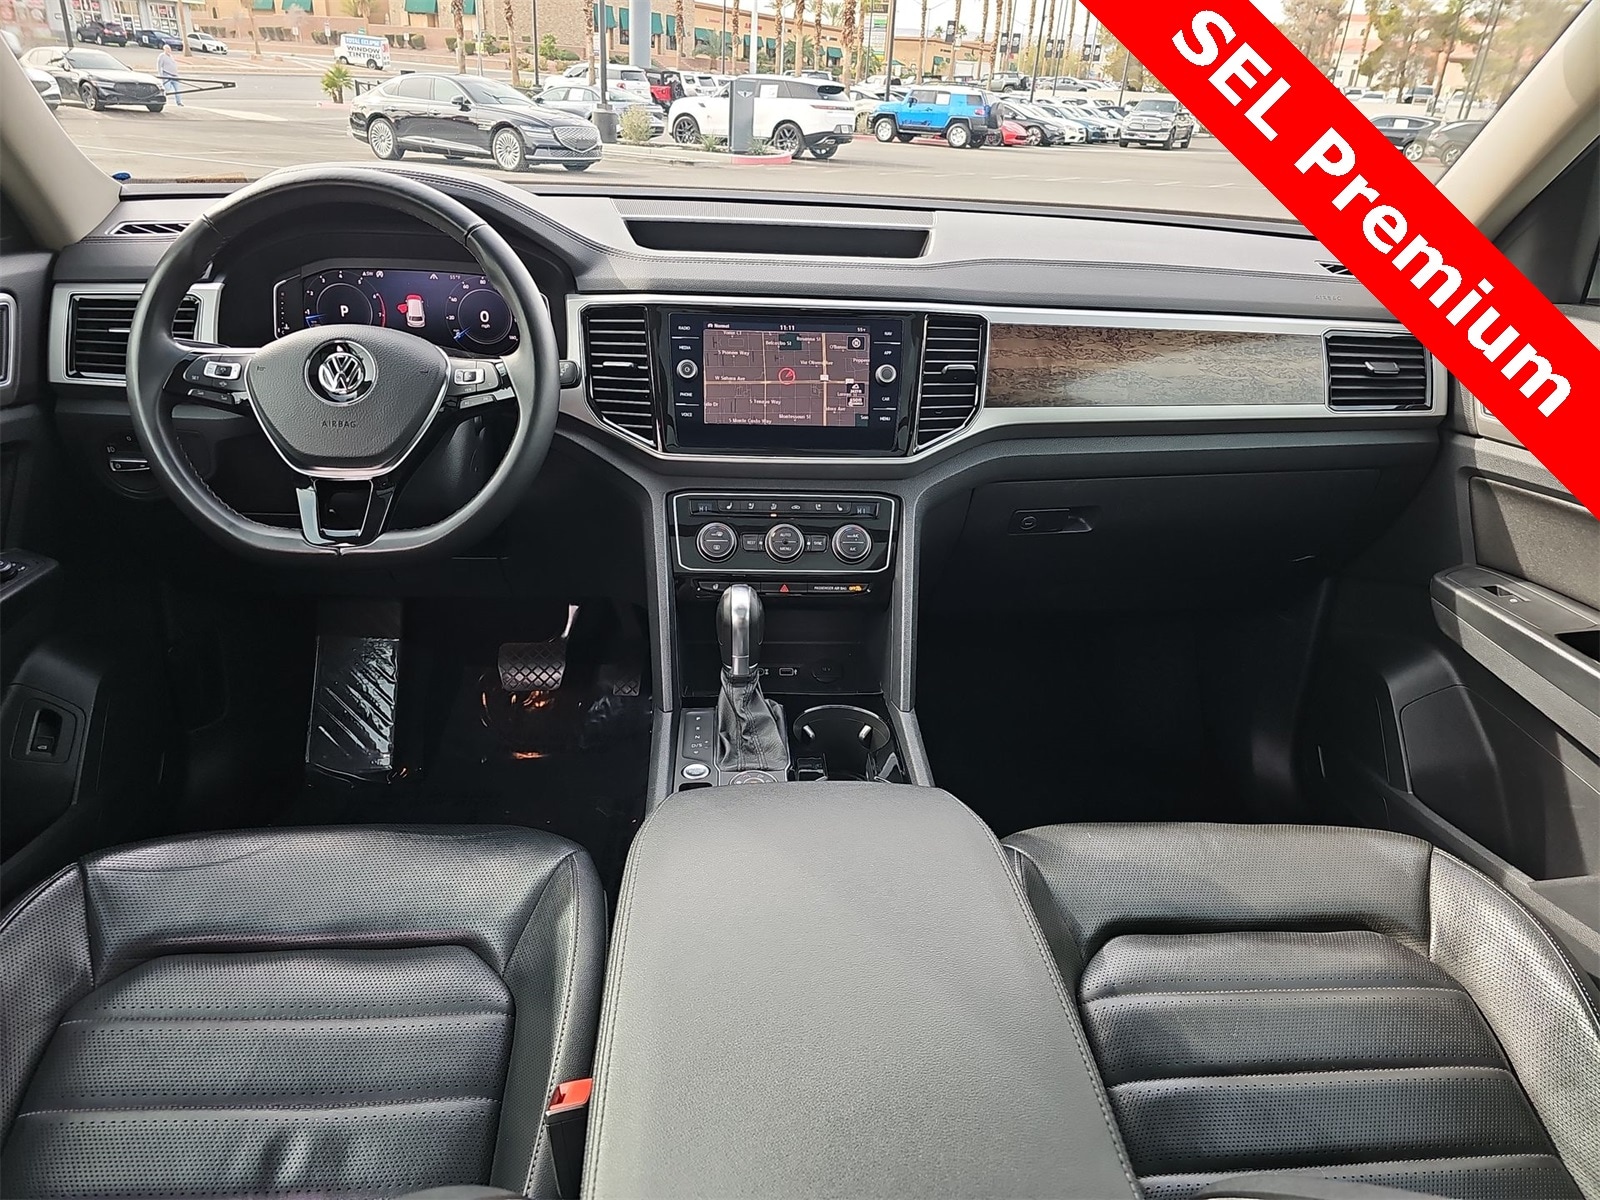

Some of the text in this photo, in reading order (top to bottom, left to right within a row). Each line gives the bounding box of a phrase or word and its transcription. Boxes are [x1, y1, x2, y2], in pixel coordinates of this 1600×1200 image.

[347, 45, 380, 53] WINDOW
[347, 51, 381, 59] TINTING
[340, 305, 349, 317] P
[480, 310, 489, 322] 0
[321, 420, 357, 428] AIRBAG
